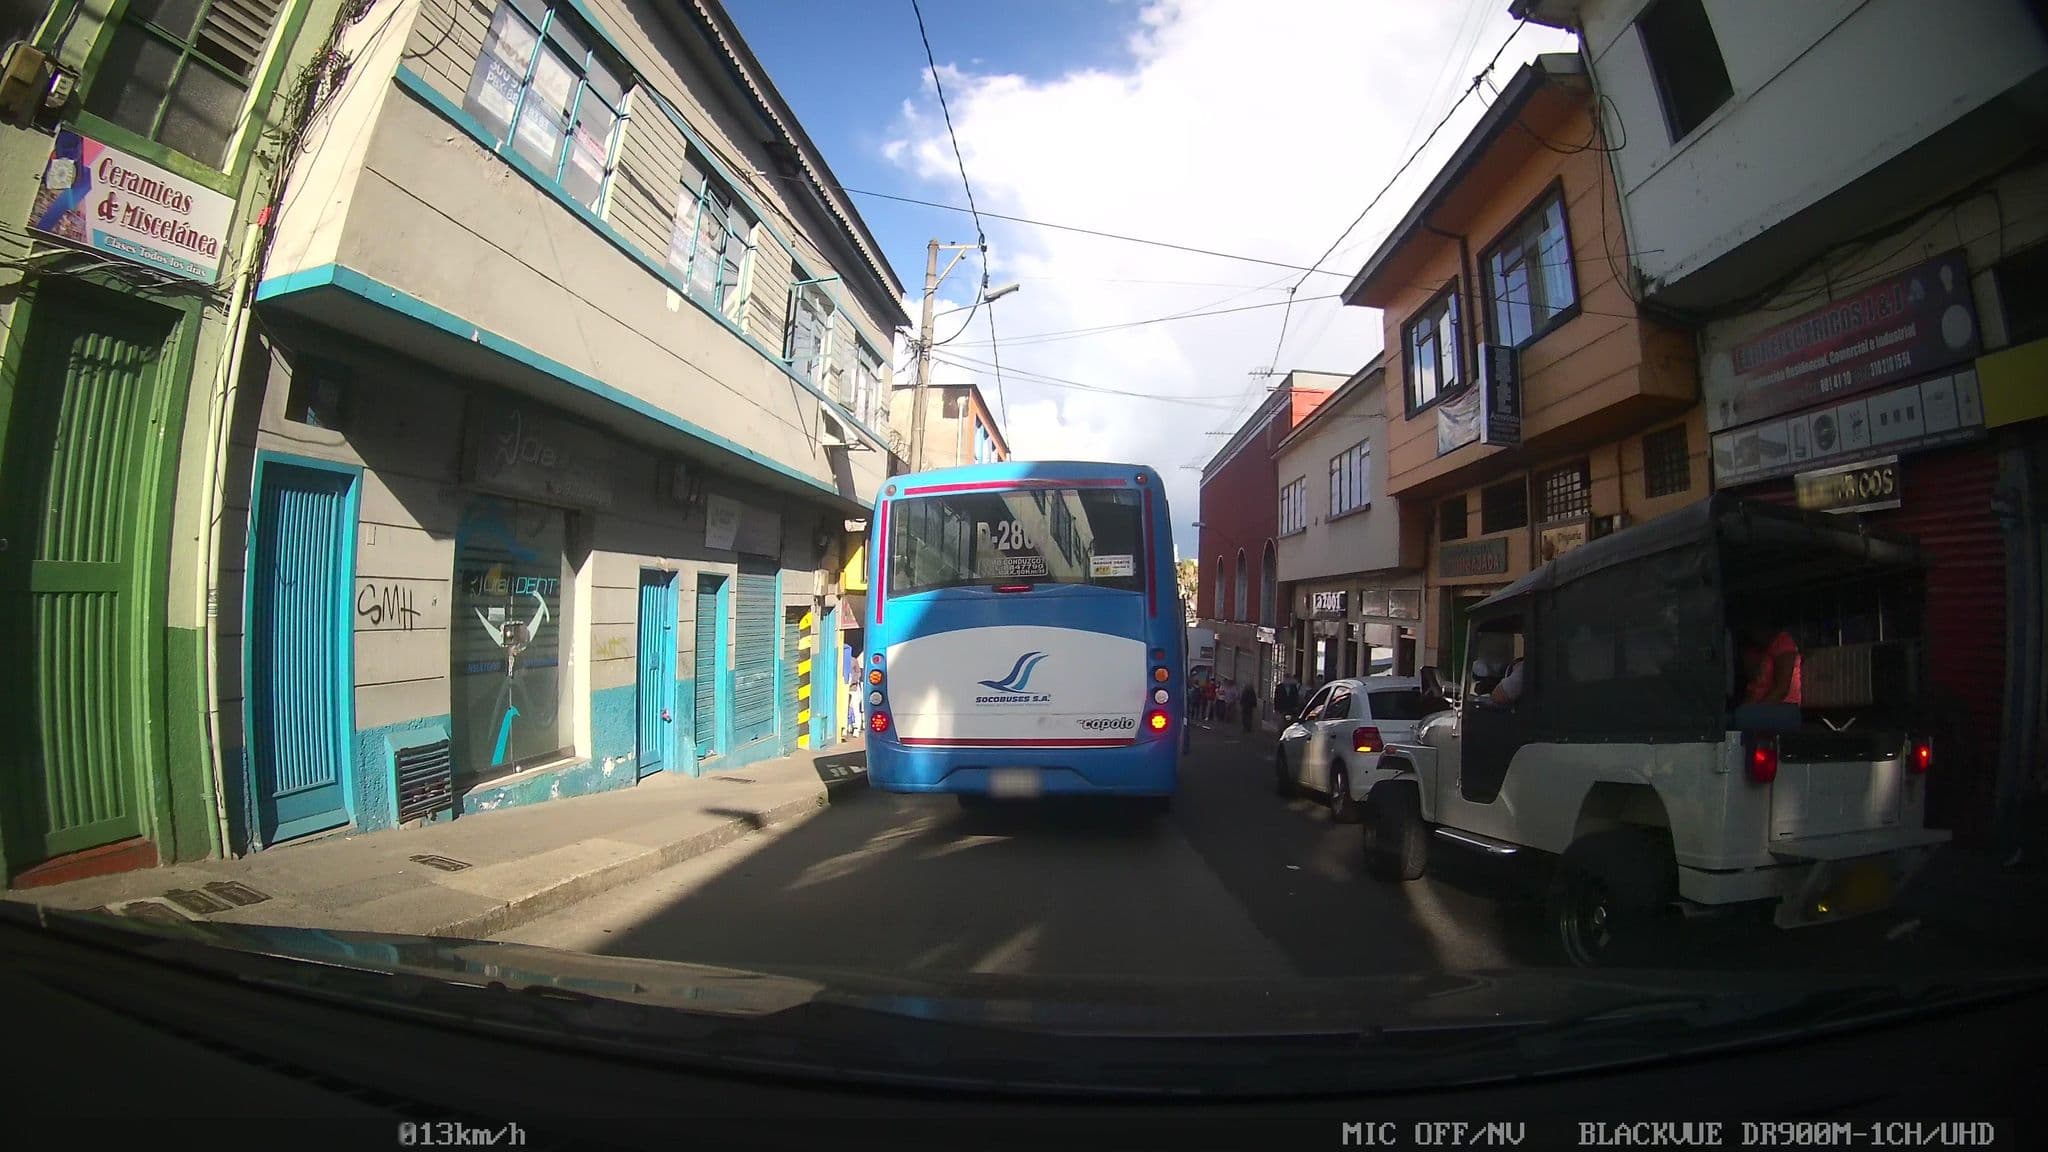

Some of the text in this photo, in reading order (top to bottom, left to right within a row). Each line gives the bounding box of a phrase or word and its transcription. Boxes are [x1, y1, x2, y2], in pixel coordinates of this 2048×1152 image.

[98, 157, 194, 215] Ceramicas
[98, 192, 218, 258] & Miscelánea
[104, 236, 136, 253] Clases
[138, 243, 169, 264] Todos
[170, 255, 186, 270] los
[357, 583, 421, 632] SMH
[975, 695, 1030, 703] SOCOBUSES
